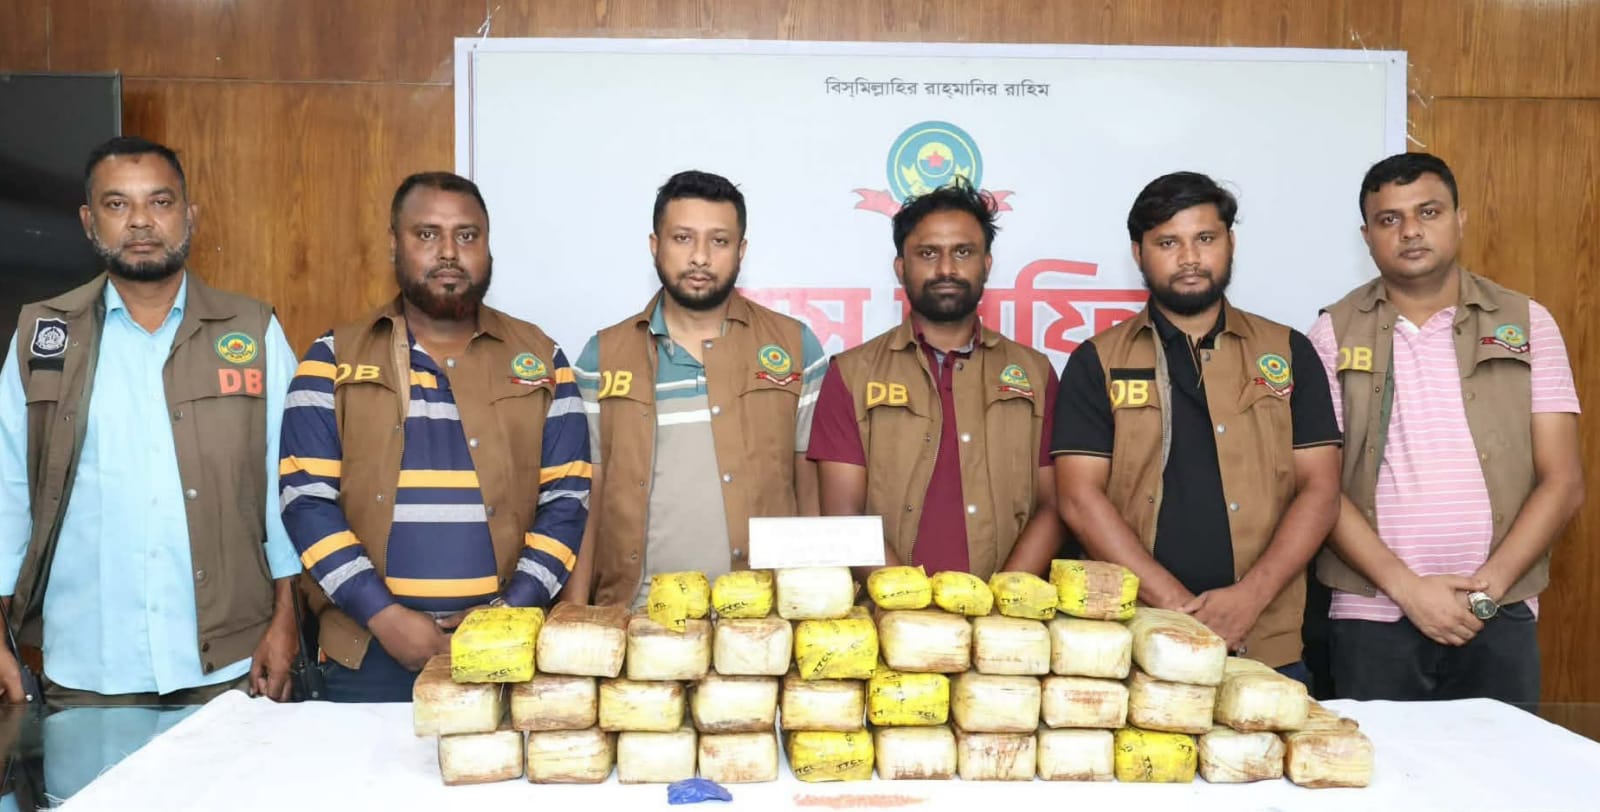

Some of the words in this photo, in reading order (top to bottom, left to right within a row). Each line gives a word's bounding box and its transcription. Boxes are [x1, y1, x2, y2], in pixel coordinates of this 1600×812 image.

[1004, 79, 1050, 97] রাহিম
[218, 368, 263, 395] DB
[866, 381, 909, 406] DB
[813, 651, 833, 673] TTCL
[836, 759, 864, 773] TTCL
